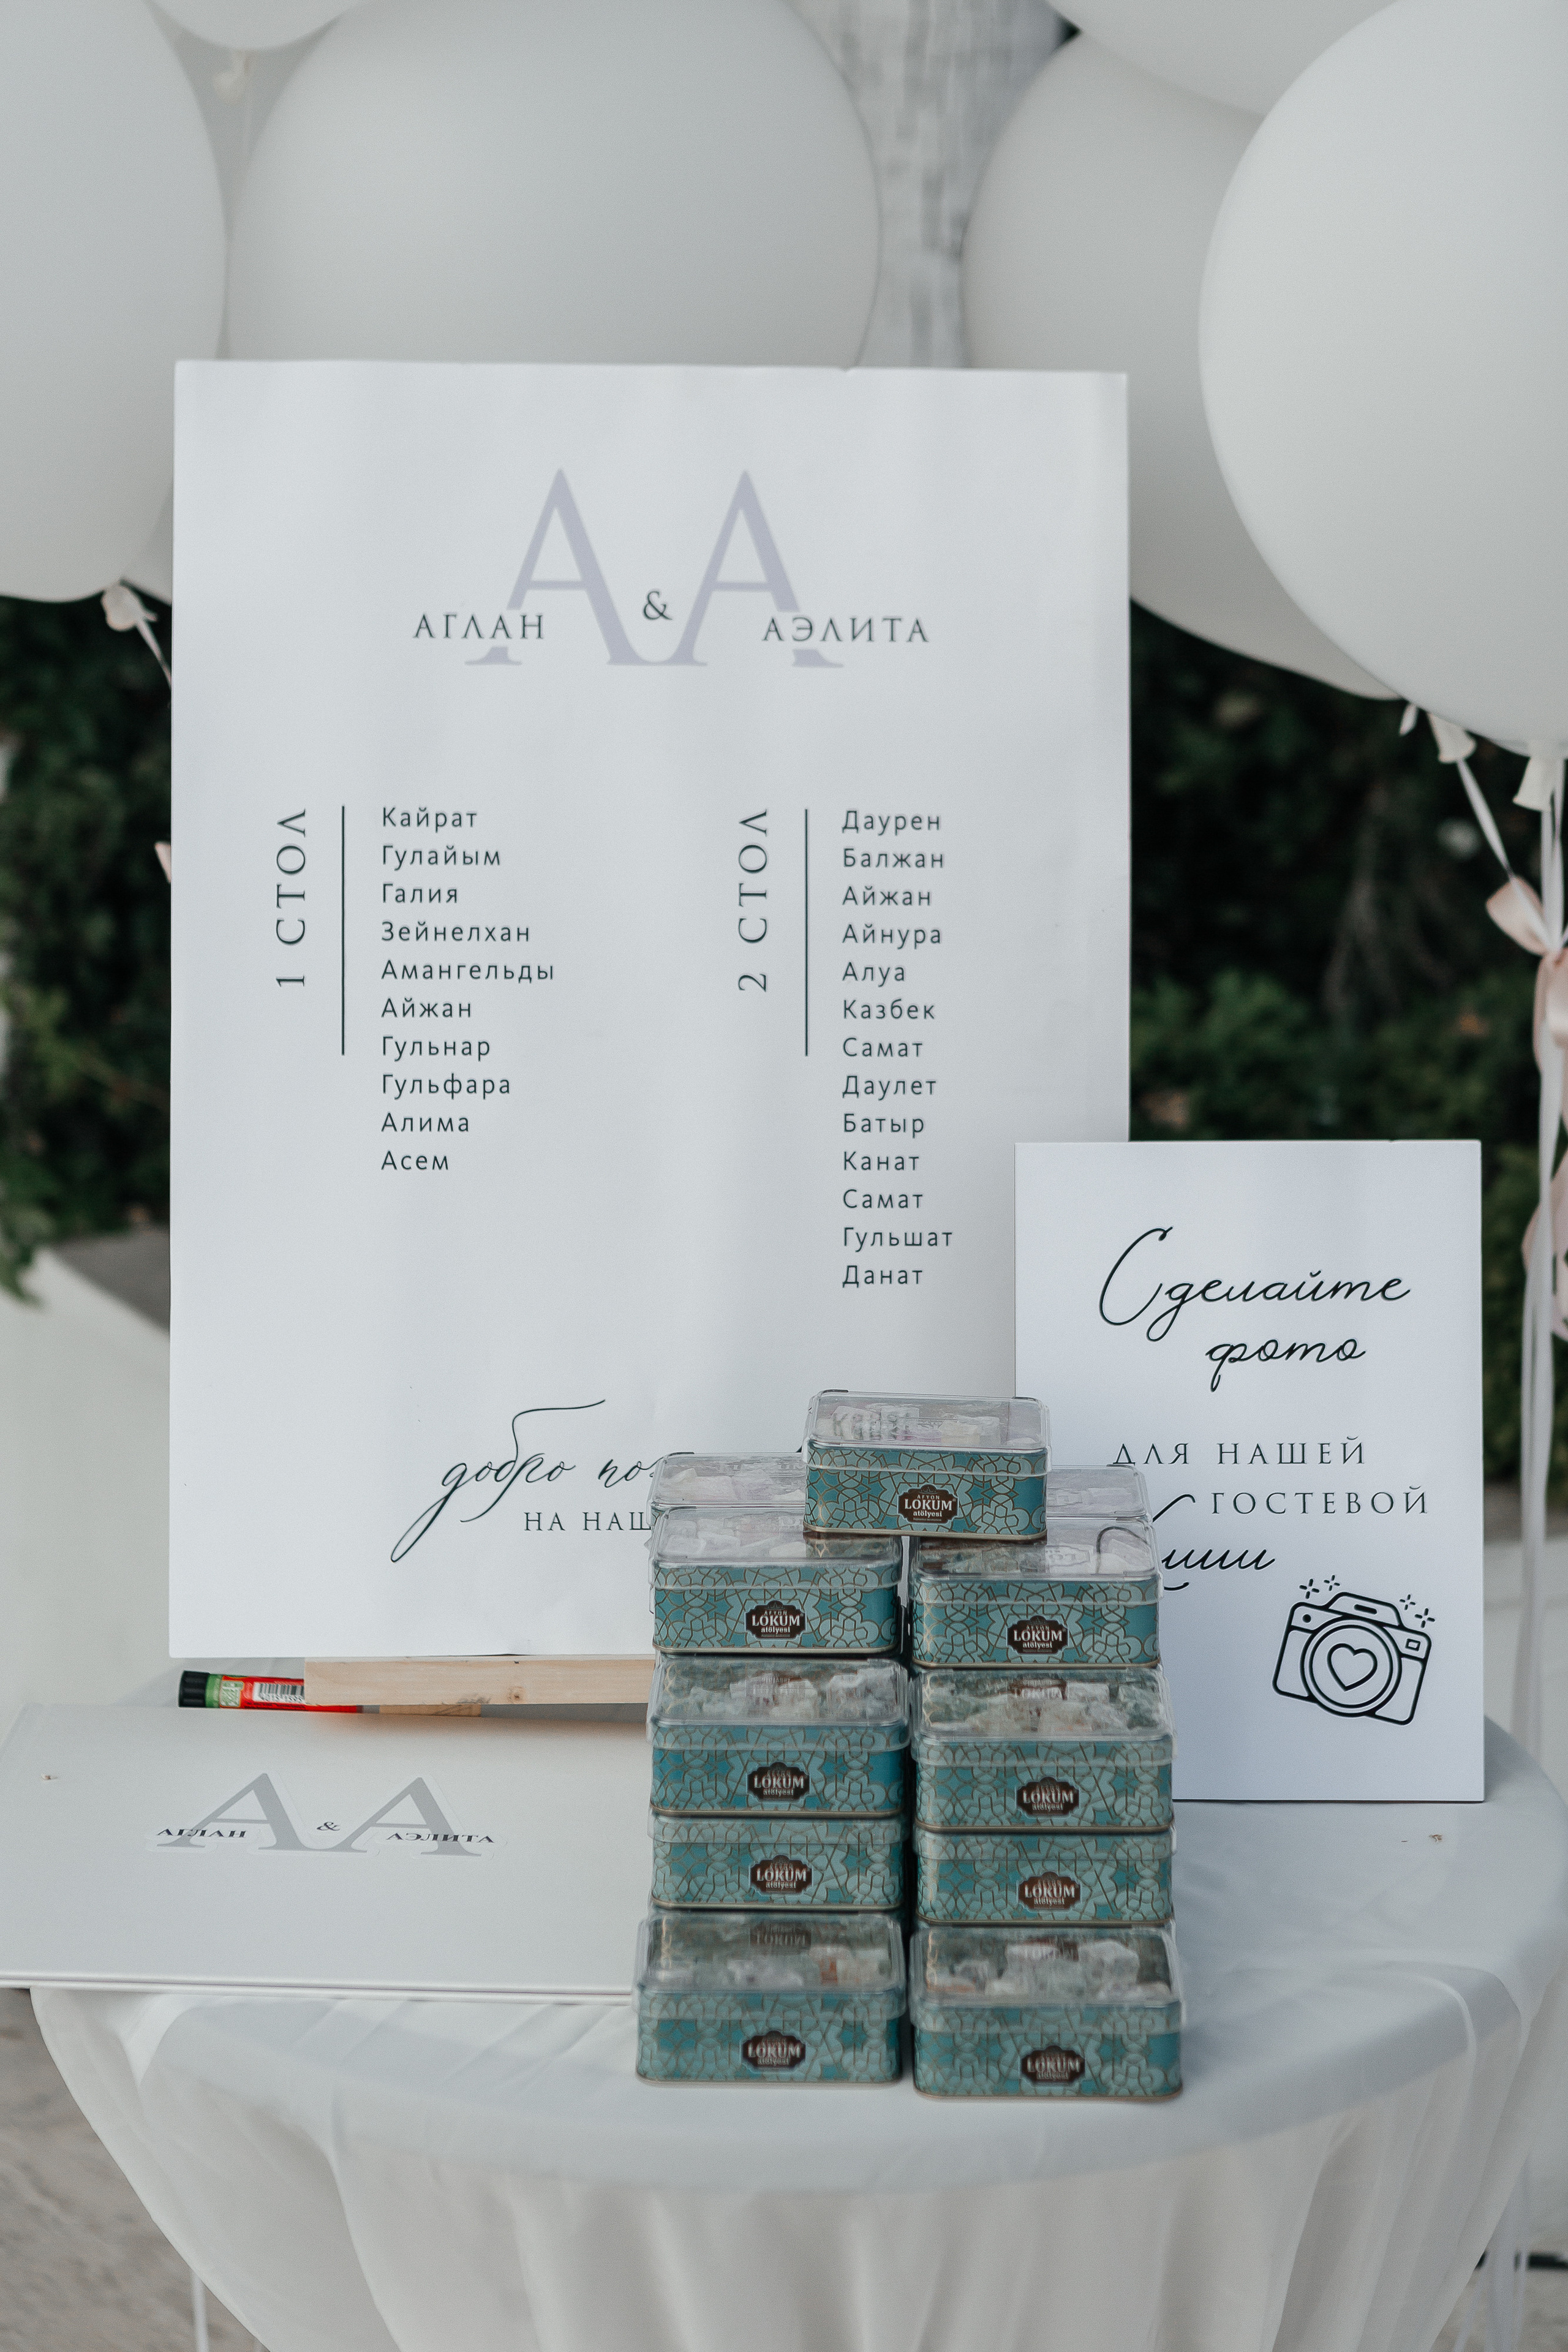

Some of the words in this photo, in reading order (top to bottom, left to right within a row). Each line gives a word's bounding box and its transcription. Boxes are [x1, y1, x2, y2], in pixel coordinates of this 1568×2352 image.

[413, 613, 543, 639] АГЛАН
[642, 590, 673, 621] &
[763, 616, 929, 643] АЭЛИТА
[382, 806, 477, 834] Кайрат
[841, 810, 940, 837] Даурен
[382, 844, 500, 872] Гулайым
[843, 847, 944, 869] Балжан
[275, 809, 306, 946] СТОЛ
[737, 809, 768, 944] СТОЛ
[382, 883, 458, 903] Галия
[842, 885, 931, 907] Айжан
[381, 921, 529, 942] Зейнелхан
[842, 923, 941, 950] Айнура
[275, 975, 306, 987] 1
[381, 959, 554, 984] Амангельды
[842, 961, 905, 988] Алуа
[737, 973, 767, 993] 2
[380, 997, 471, 1018] Айжан
[843, 998, 935, 1020] Казбек
[382, 1035, 491, 1063] Гульнар
[842, 1036, 923, 1058] Самат
[382, 1072, 510, 1101] Гульфара
[842, 1074, 937, 1101] Даулет
[380, 1112, 469, 1133] Алима
[843, 1112, 924, 1139] Батыр
[380, 1150, 449, 1171] Асем
[843, 1150, 920, 1171] Канат
[842, 1188, 924, 1209] Самат
[843, 1226, 953, 1253] Гульшат
[842, 1264, 923, 1289] Данат
[1098, 1226, 1411, 1342] Сделайте
[1204, 1338, 1366, 1393] фото
[1112, 1442, 1189, 1466] ДЛЯ
[1216, 1436, 1364, 1464] НАШЕЙ
[390, 1400, 606, 1564] добро
[905, 1498, 952, 1511] LOKUM
[1212, 1485, 1428, 1515] ГОСТЕВОЙ
[524, 1512, 566, 1531] НА
[582, 1511, 652, 1531] НАШ
[752, 1615, 801, 1626] LOKUM
[1013, 1629, 1063, 1642] LOKUM
[753, 1775, 804, 1789] LOKUM
[1022, 1789, 1074, 1804] LOKUM
[156, 1828, 247, 1838] АГЛАН
[316, 1821, 341, 1832] &
[385, 1832, 495, 1844] АЭЛИТА
[756, 1868, 807, 1882] LOKUM
[1024, 1883, 1076, 1898] LOKUM
